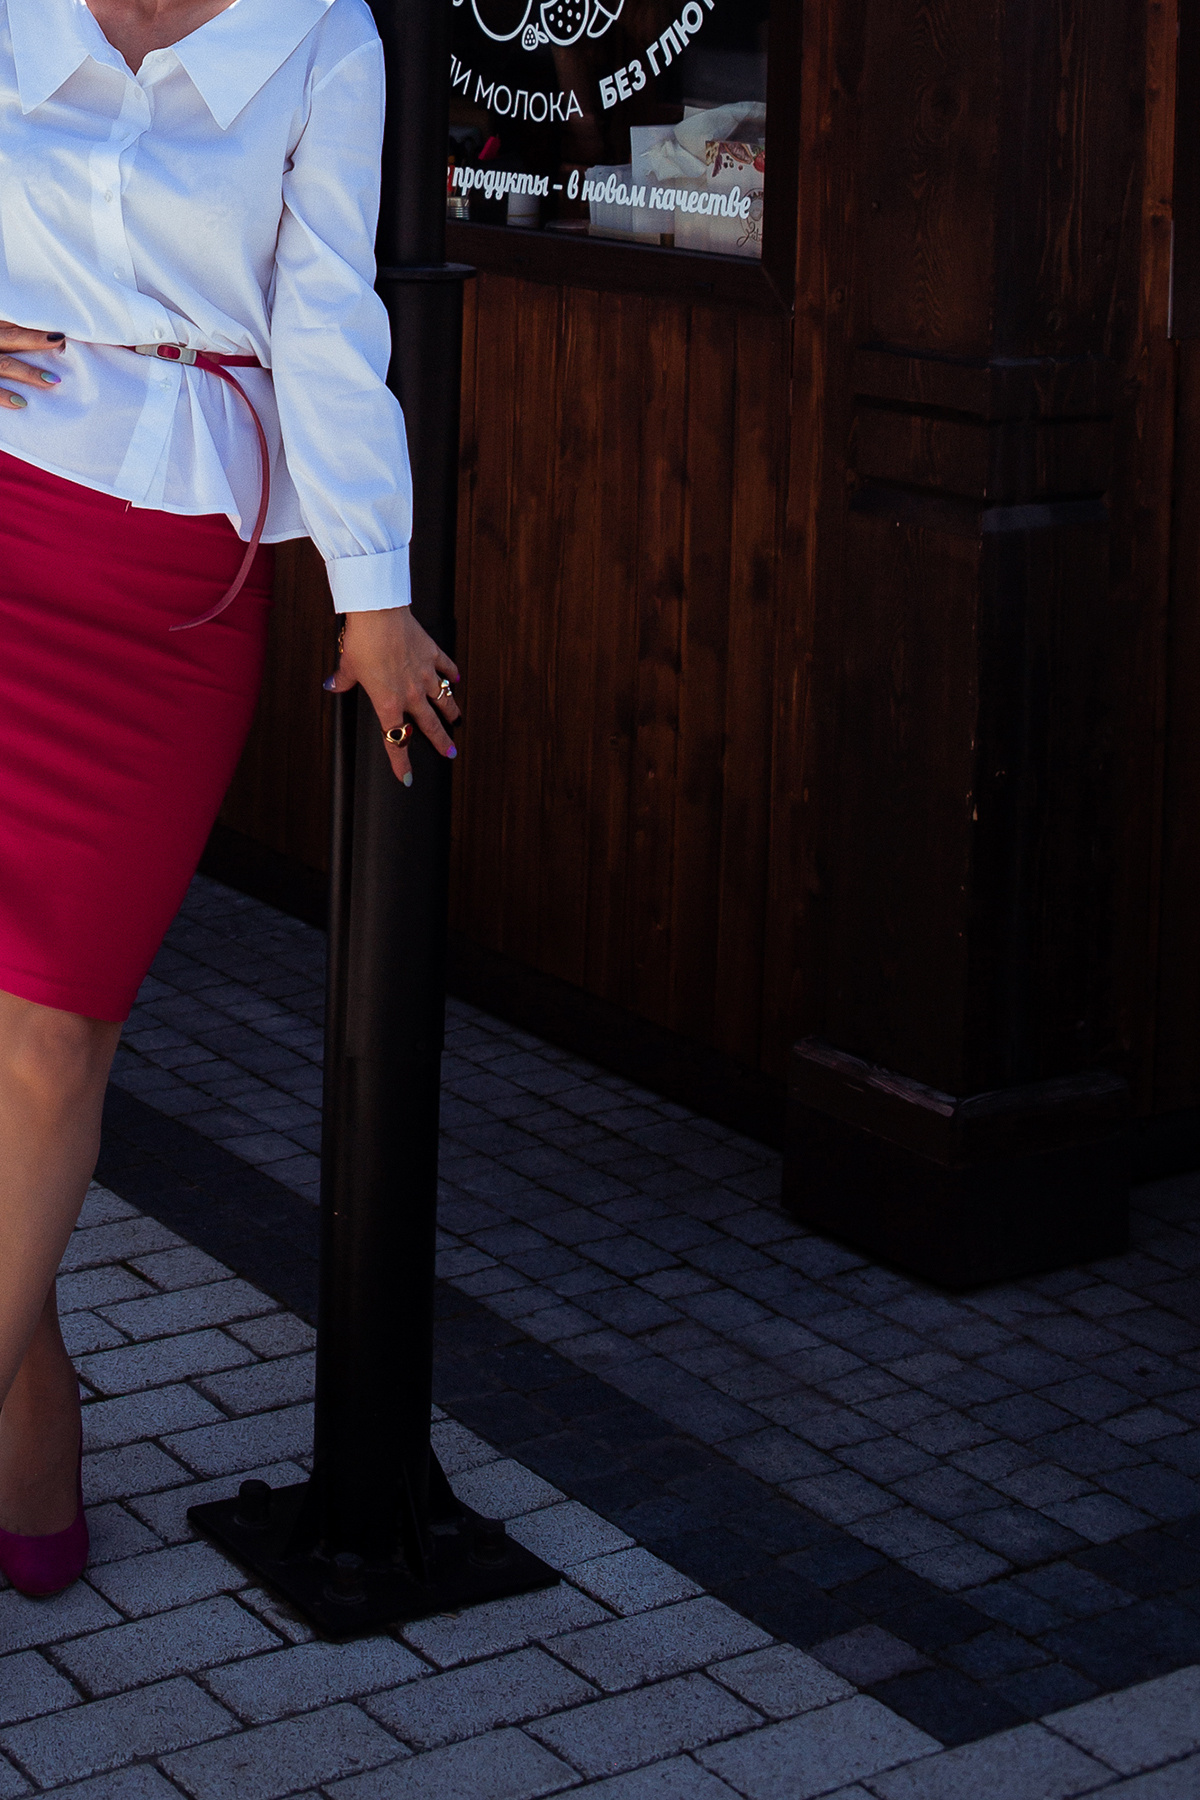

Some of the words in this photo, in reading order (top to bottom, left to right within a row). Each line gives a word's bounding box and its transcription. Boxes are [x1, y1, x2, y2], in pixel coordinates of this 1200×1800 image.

[474, 74, 584, 123] МОЛОКА
[598, 59, 647, 110] БЕЗ
[451, 166, 550, 200] продукты
[567, 169, 580, 200] в
[581, 173, 647, 208] новом
[649, 185, 751, 219] качестве
